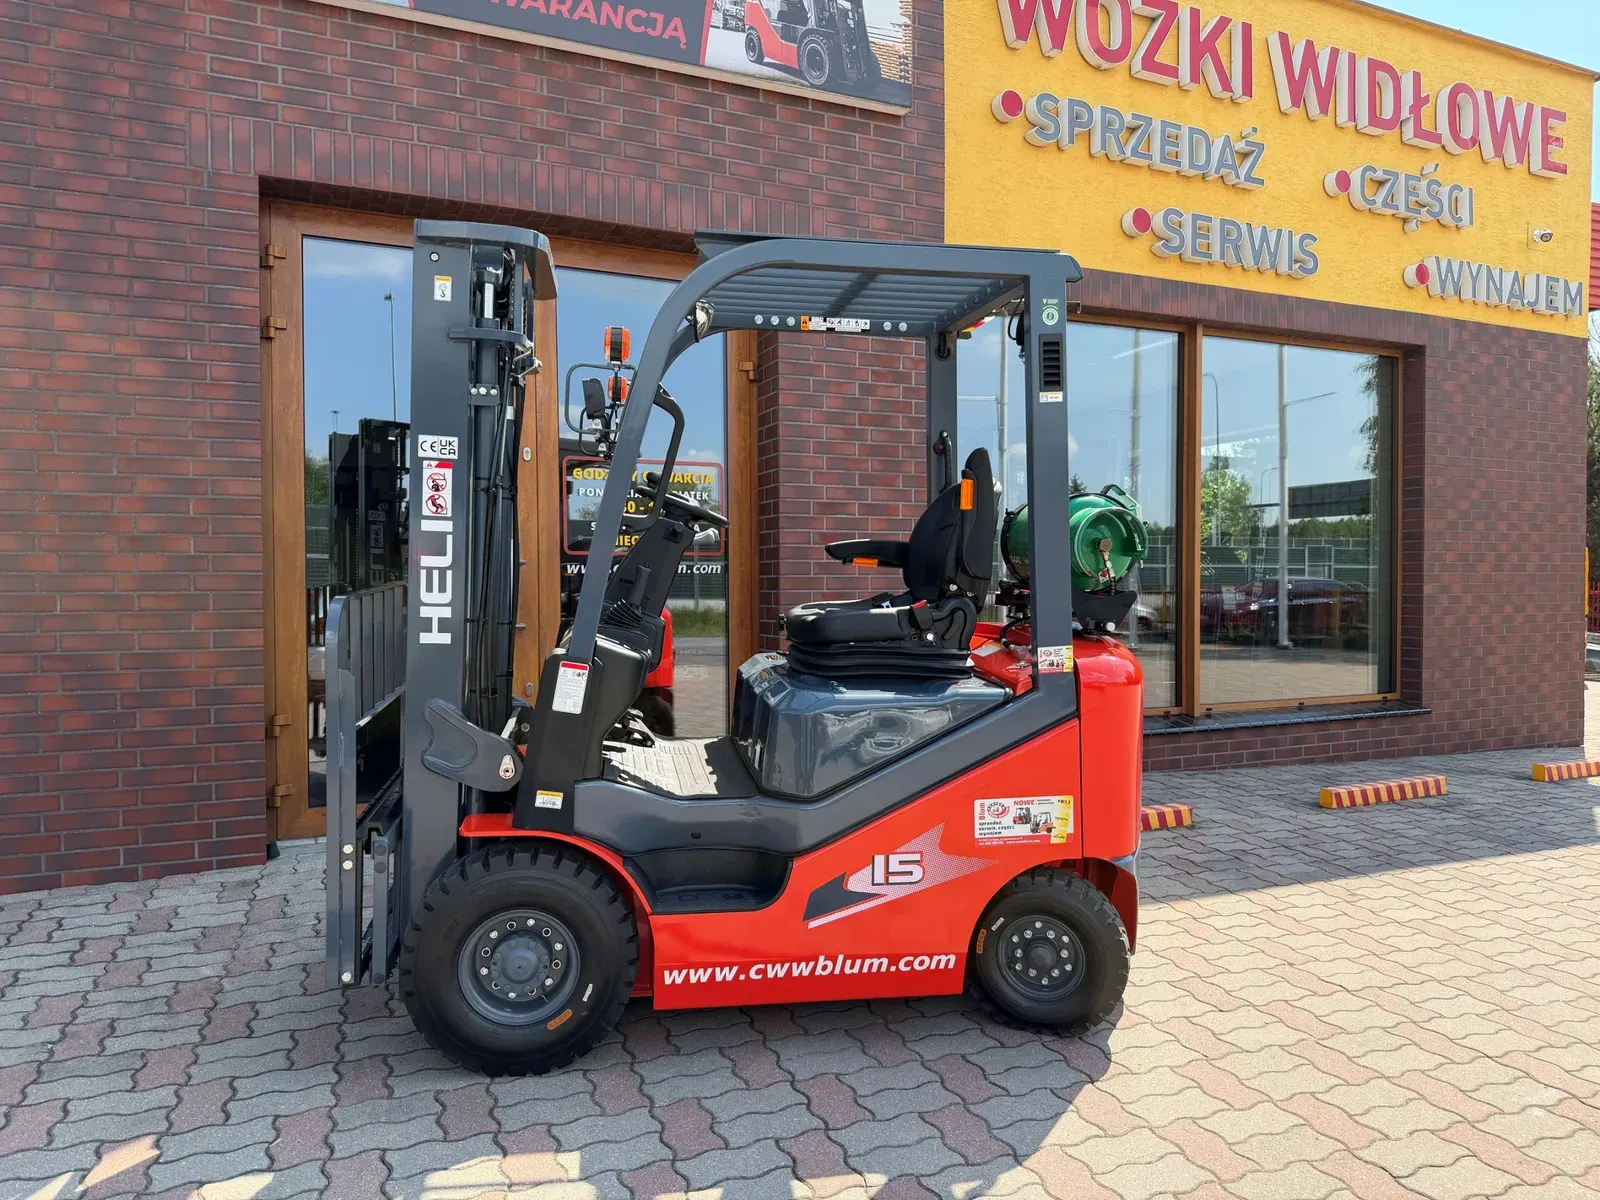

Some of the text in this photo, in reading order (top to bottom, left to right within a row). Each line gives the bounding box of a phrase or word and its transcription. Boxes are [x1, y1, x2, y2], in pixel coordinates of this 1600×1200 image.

[490, 0, 687, 49] ARANCJĄ
[1268, 30, 1568, 178] WIDŁOWE
[1027, 92, 1265, 190] SPRZEDAŻ
[1351, 163, 1474, 233] CZĘŚCI
[1152, 207, 1320, 278] SERWIS
[1424, 256, 1583, 318] WYNAJEM
[419, 519, 453, 644] HELI
[663, 953, 956, 985] www.cwwblum.com
